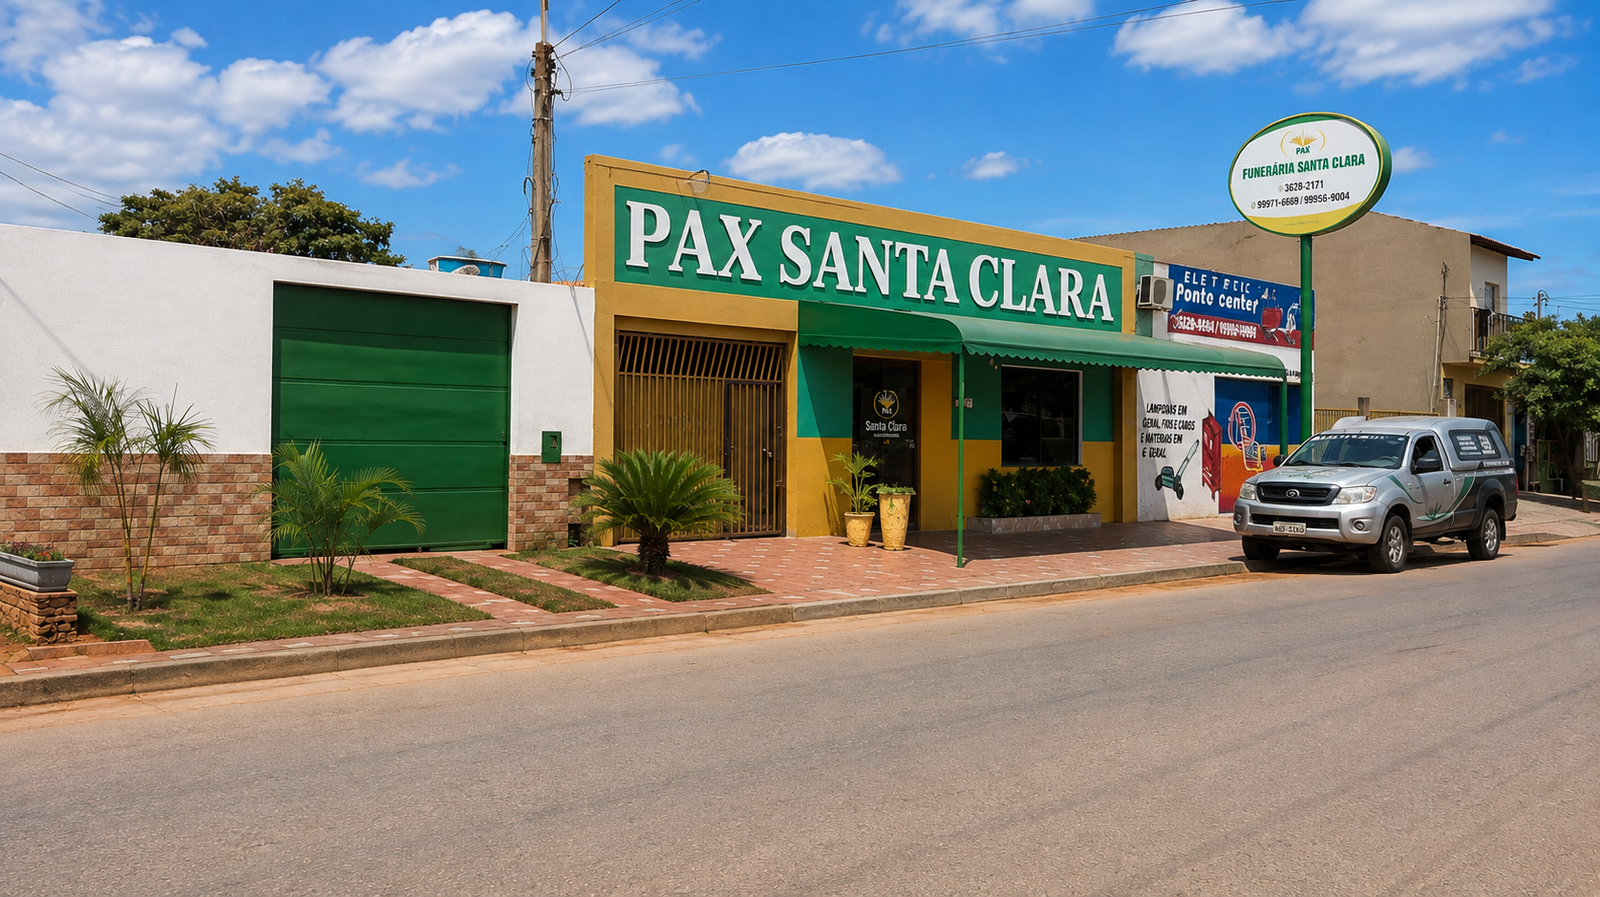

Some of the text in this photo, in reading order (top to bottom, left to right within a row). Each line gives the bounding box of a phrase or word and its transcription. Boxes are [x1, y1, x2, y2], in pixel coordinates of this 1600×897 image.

[1296, 146, 1310, 155] PAX
[1242, 153, 1365, 180] FUNERÁRIA SANTA CLARA
[1284, 180, 1324, 193] 3628-2171
[625, 200, 1115, 322] PAX SANTA CLARA
[1219, 294, 1259, 315] center
[865, 420, 908, 432] Santa Clara
